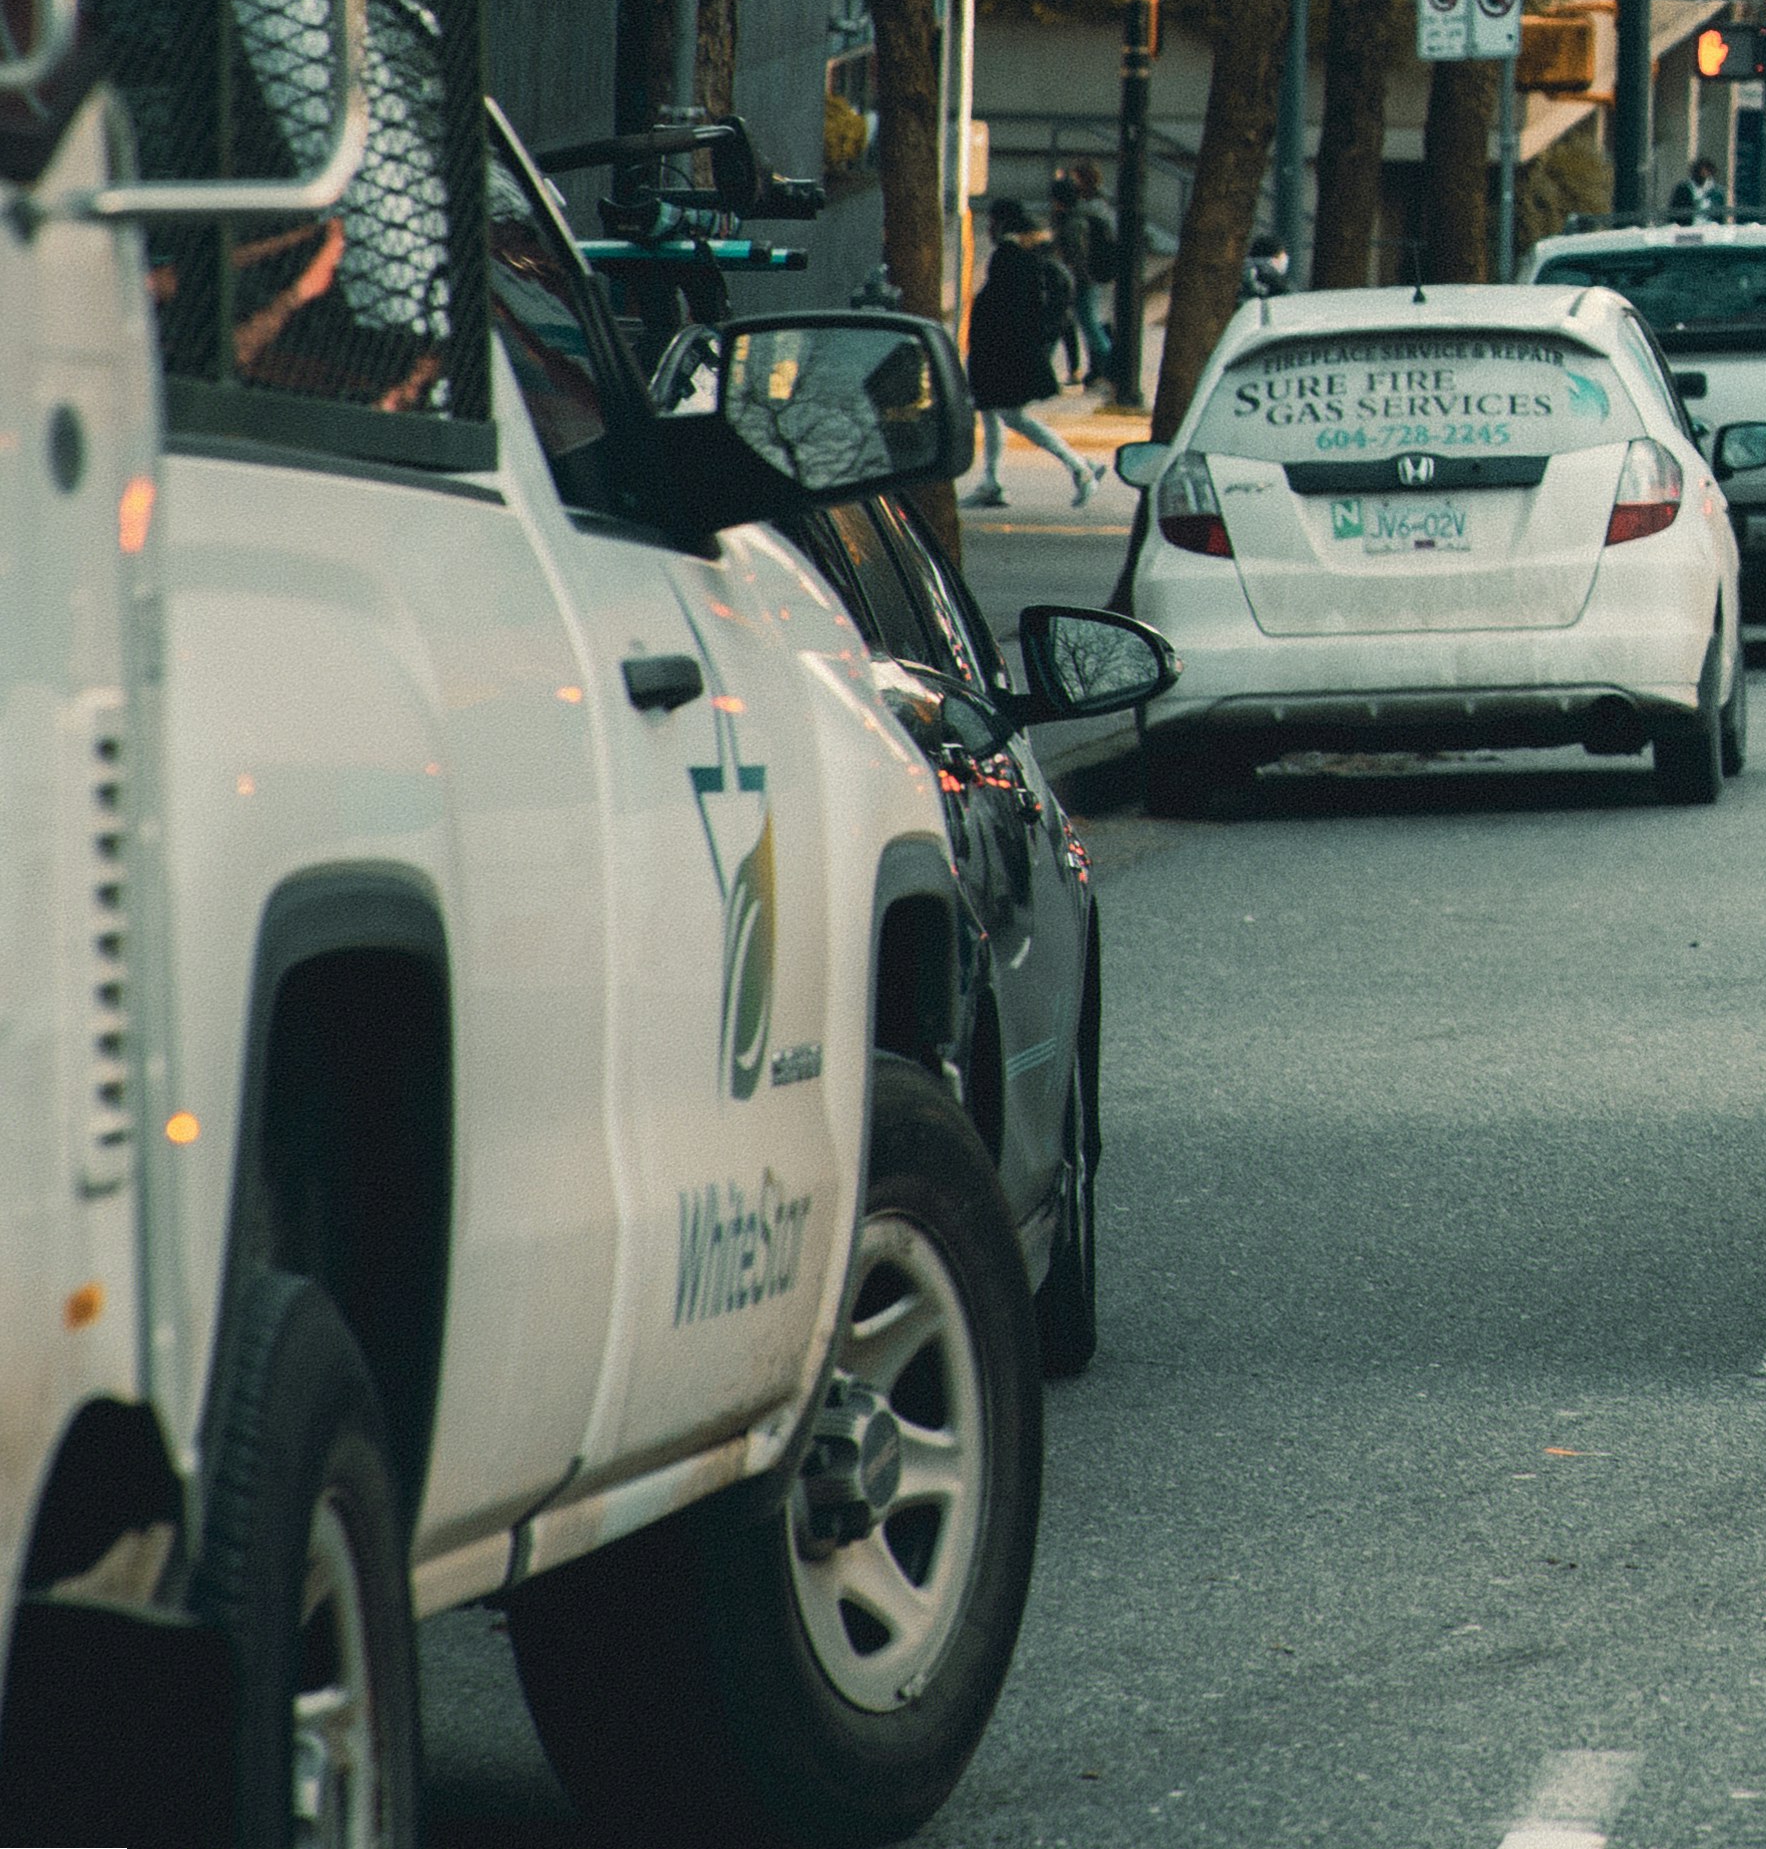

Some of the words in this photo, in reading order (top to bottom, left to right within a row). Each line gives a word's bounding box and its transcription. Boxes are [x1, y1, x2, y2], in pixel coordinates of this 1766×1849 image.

[1263, 344, 1376, 374] FIREPLACE
[1380, 341, 1470, 363] SERVICE
[1490, 341, 1565, 368] REPAIR
[1234, 373, 1347, 418] SURE
[1366, 369, 1457, 393] FIRE
[1266, 402, 1345, 427] GAS
[1356, 394, 1553, 420] SERVICES
[1316, 423, 1512, 451] 604-728-2245
[672, 1166, 812, 1330] WhiteStar
